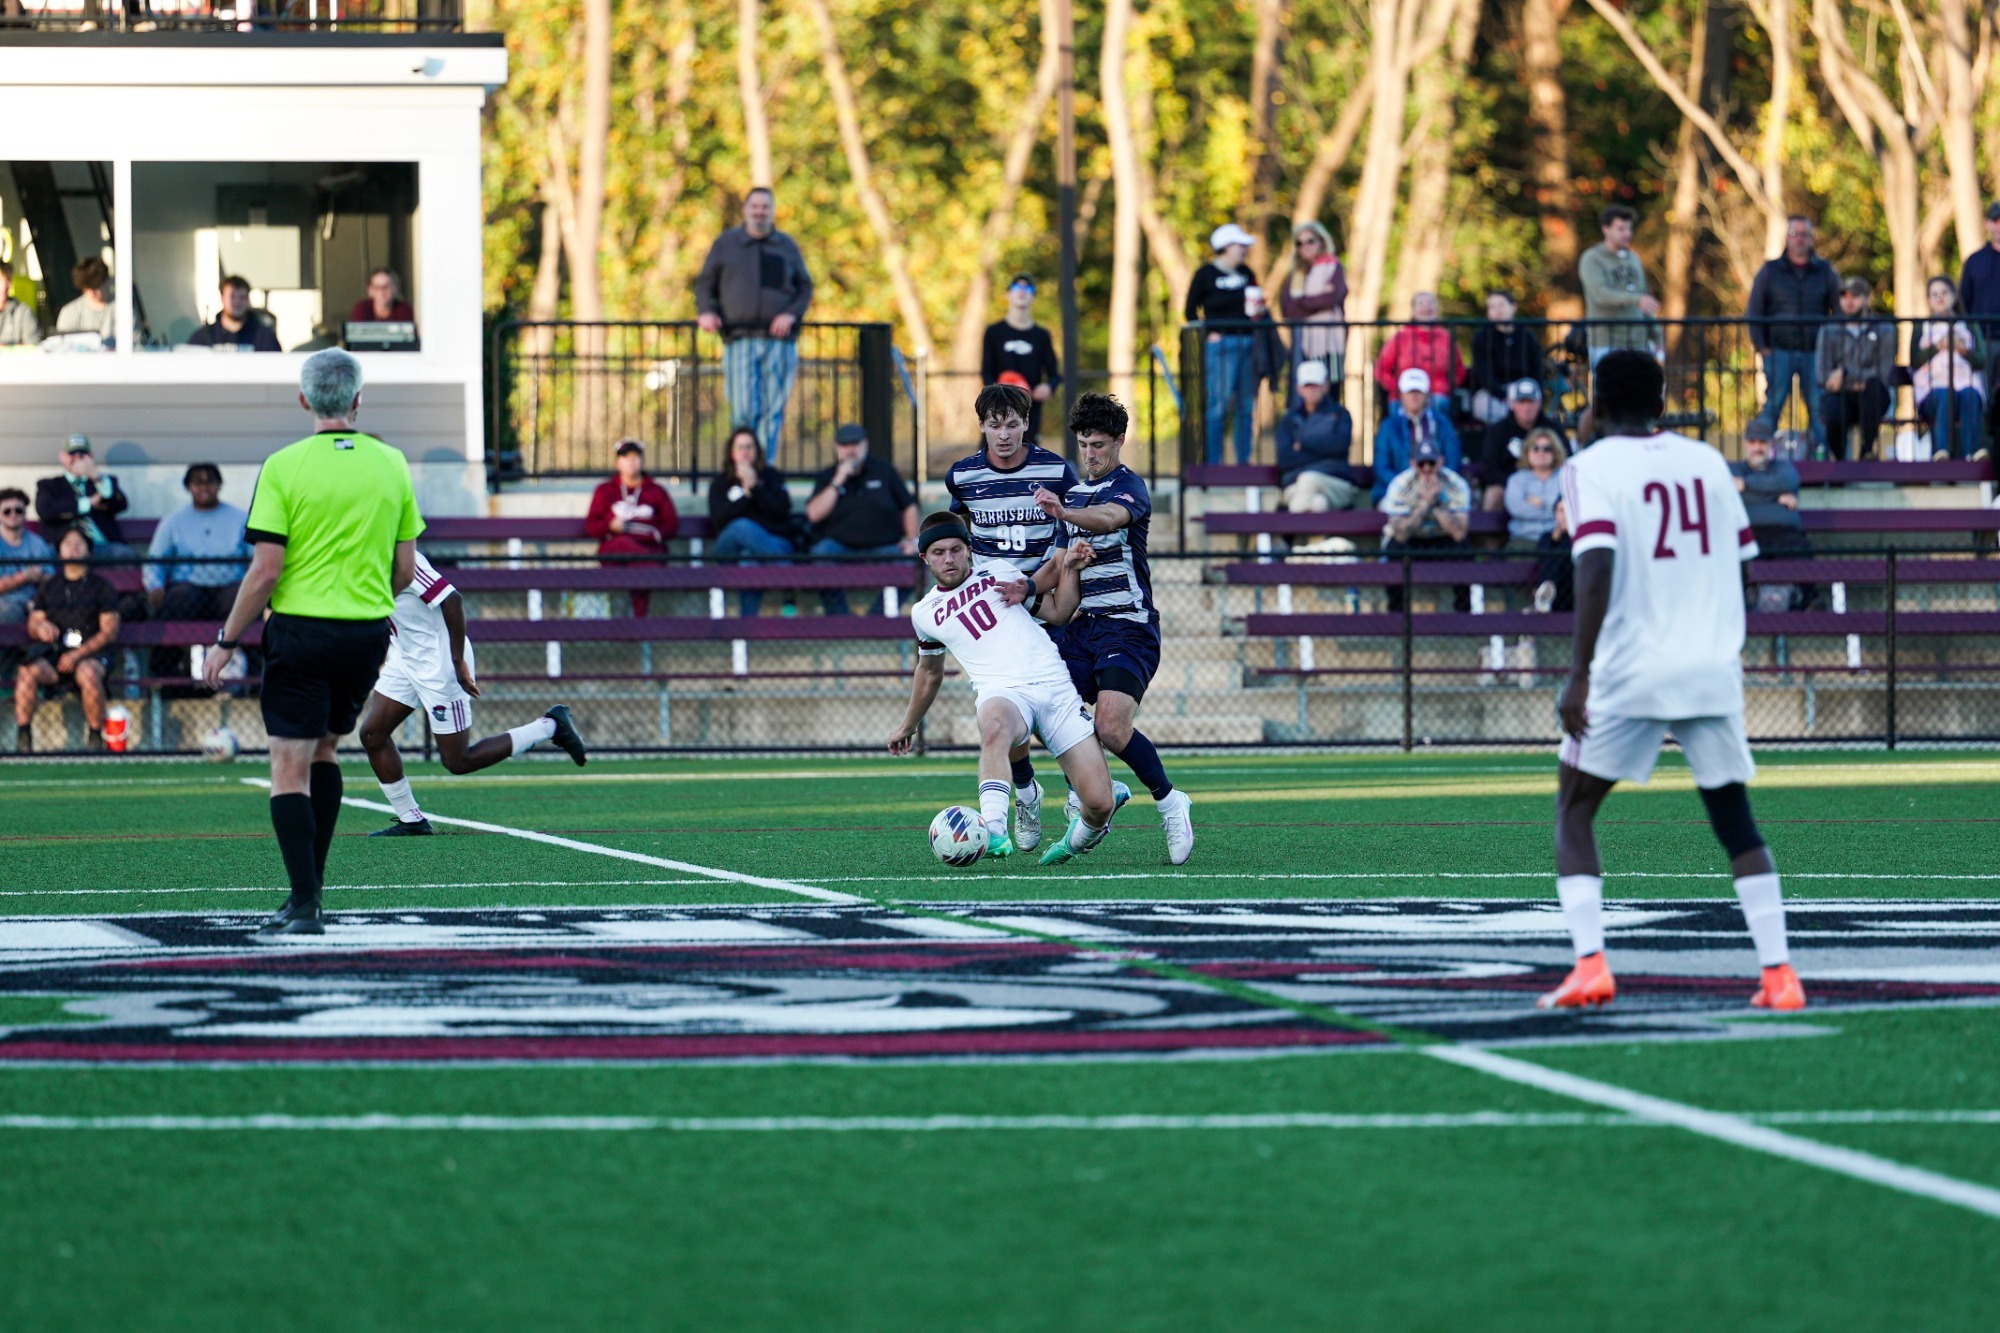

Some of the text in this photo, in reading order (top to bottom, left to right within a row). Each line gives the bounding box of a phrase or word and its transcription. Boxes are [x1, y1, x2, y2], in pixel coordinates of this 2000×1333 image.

[974, 507, 1047, 524] HARRISBURG
[1643, 477, 1710, 559] 24
[996, 525, 1027, 551] 98
[934, 575, 996, 626] CAIRN
[955, 599, 997, 641] 10
